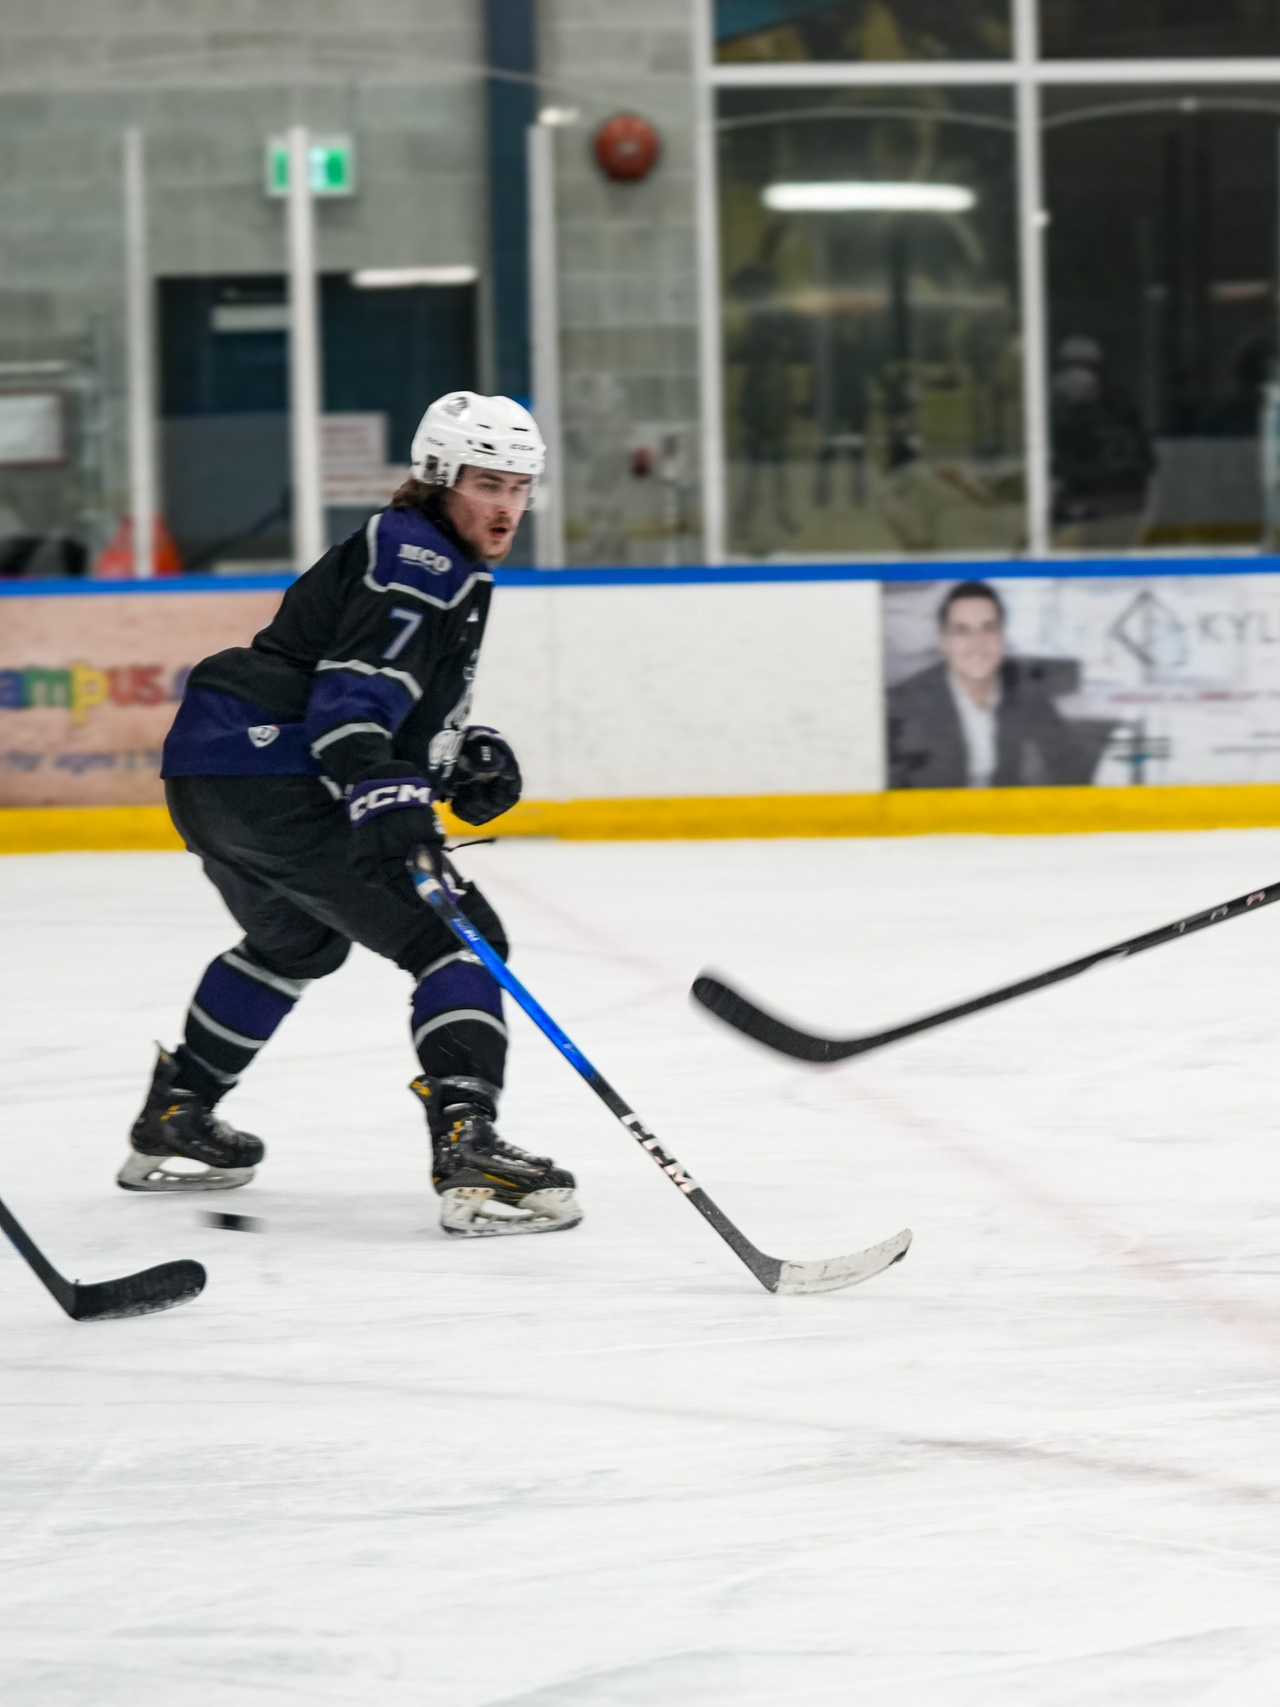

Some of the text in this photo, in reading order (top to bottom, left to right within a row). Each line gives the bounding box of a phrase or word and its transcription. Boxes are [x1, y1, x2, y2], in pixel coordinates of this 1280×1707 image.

[380, 605, 425, 662] 7
[349, 783, 433, 821] CCM
[619, 1110, 702, 1195] CCM
